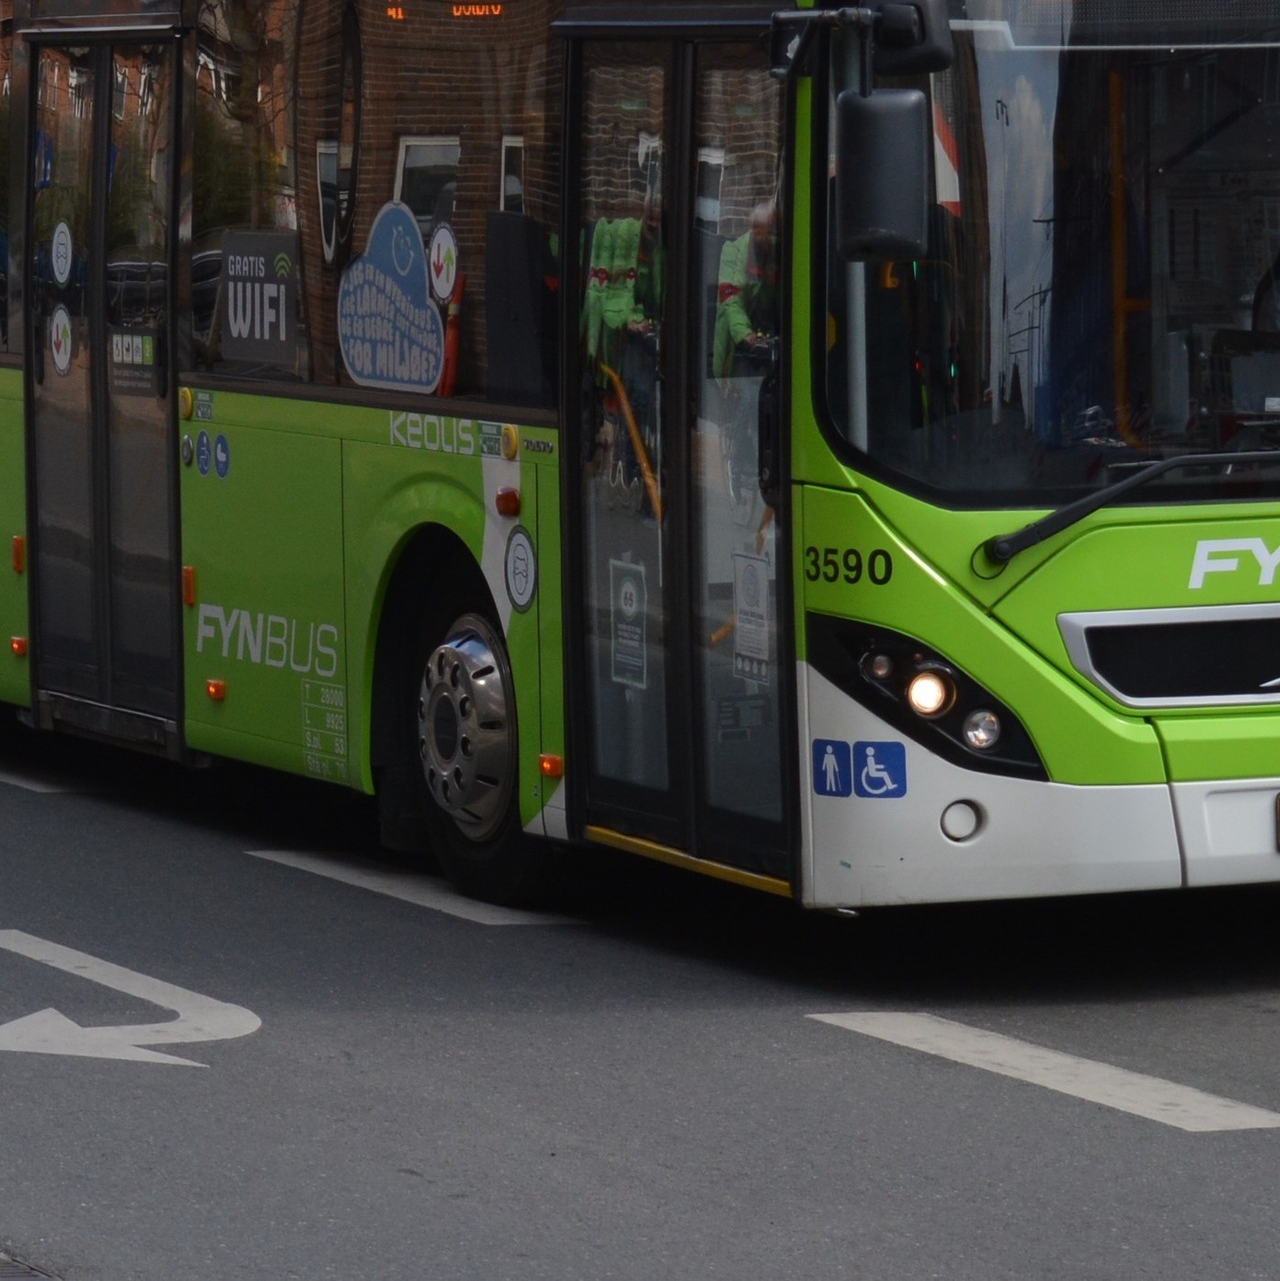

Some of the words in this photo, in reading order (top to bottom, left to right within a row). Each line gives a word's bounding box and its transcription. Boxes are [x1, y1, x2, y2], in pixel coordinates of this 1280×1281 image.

[227, 254, 266, 278] GRATIS
[227, 280, 287, 341] WIFI
[804, 546, 893, 586] 3590
[196, 603, 338, 678] FYNBUS
